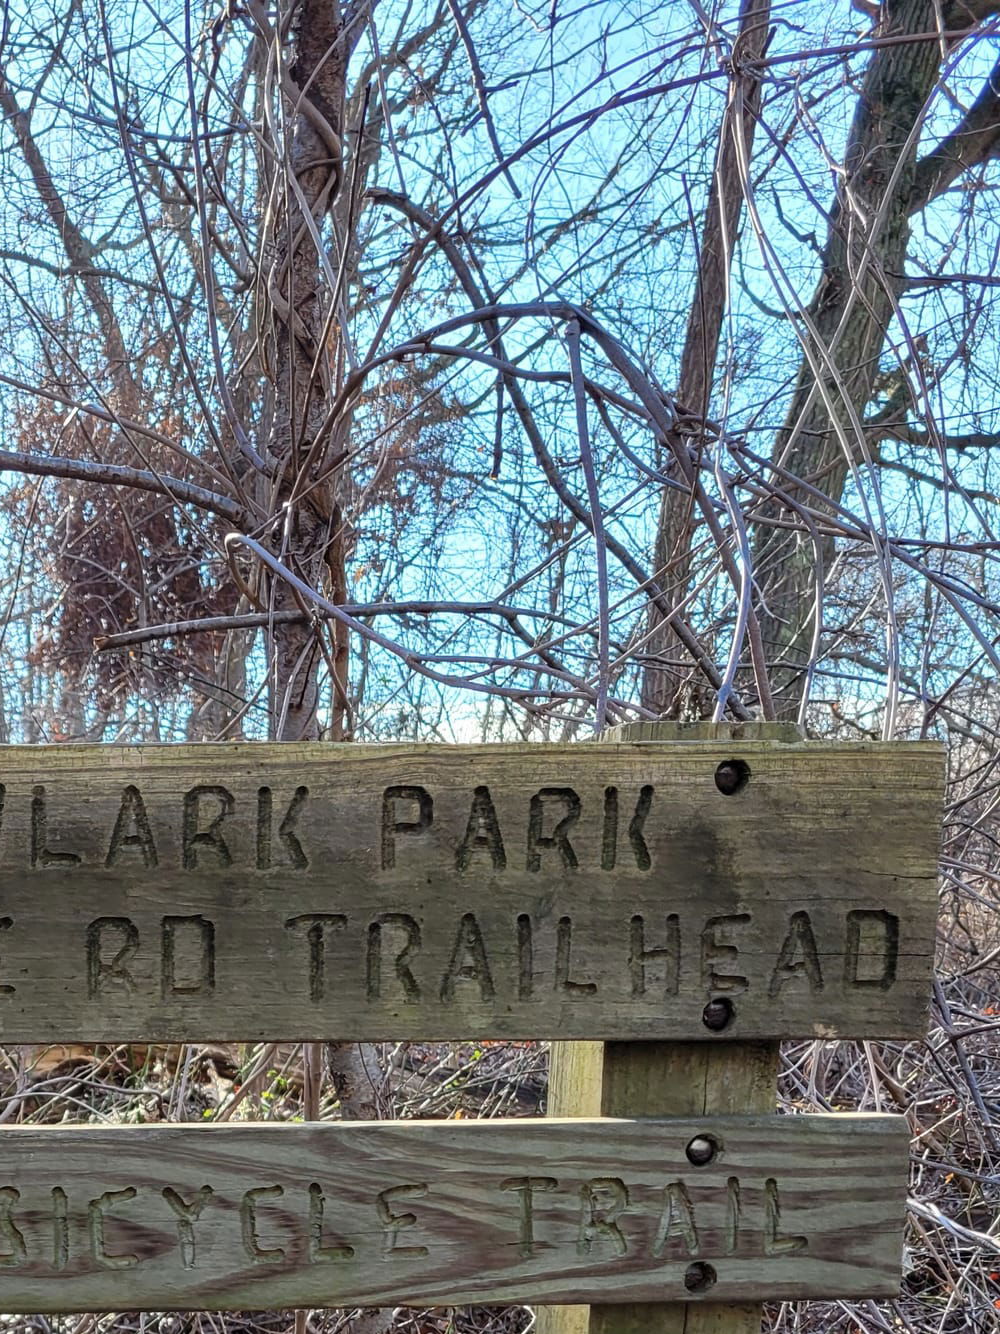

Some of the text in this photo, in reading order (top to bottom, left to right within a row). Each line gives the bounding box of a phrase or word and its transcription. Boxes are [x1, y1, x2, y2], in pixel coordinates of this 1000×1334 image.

[380, 784, 655, 873] PARK
[84, 914, 216, 1000] RD
[500, 1175, 808, 1258] TRAIL
